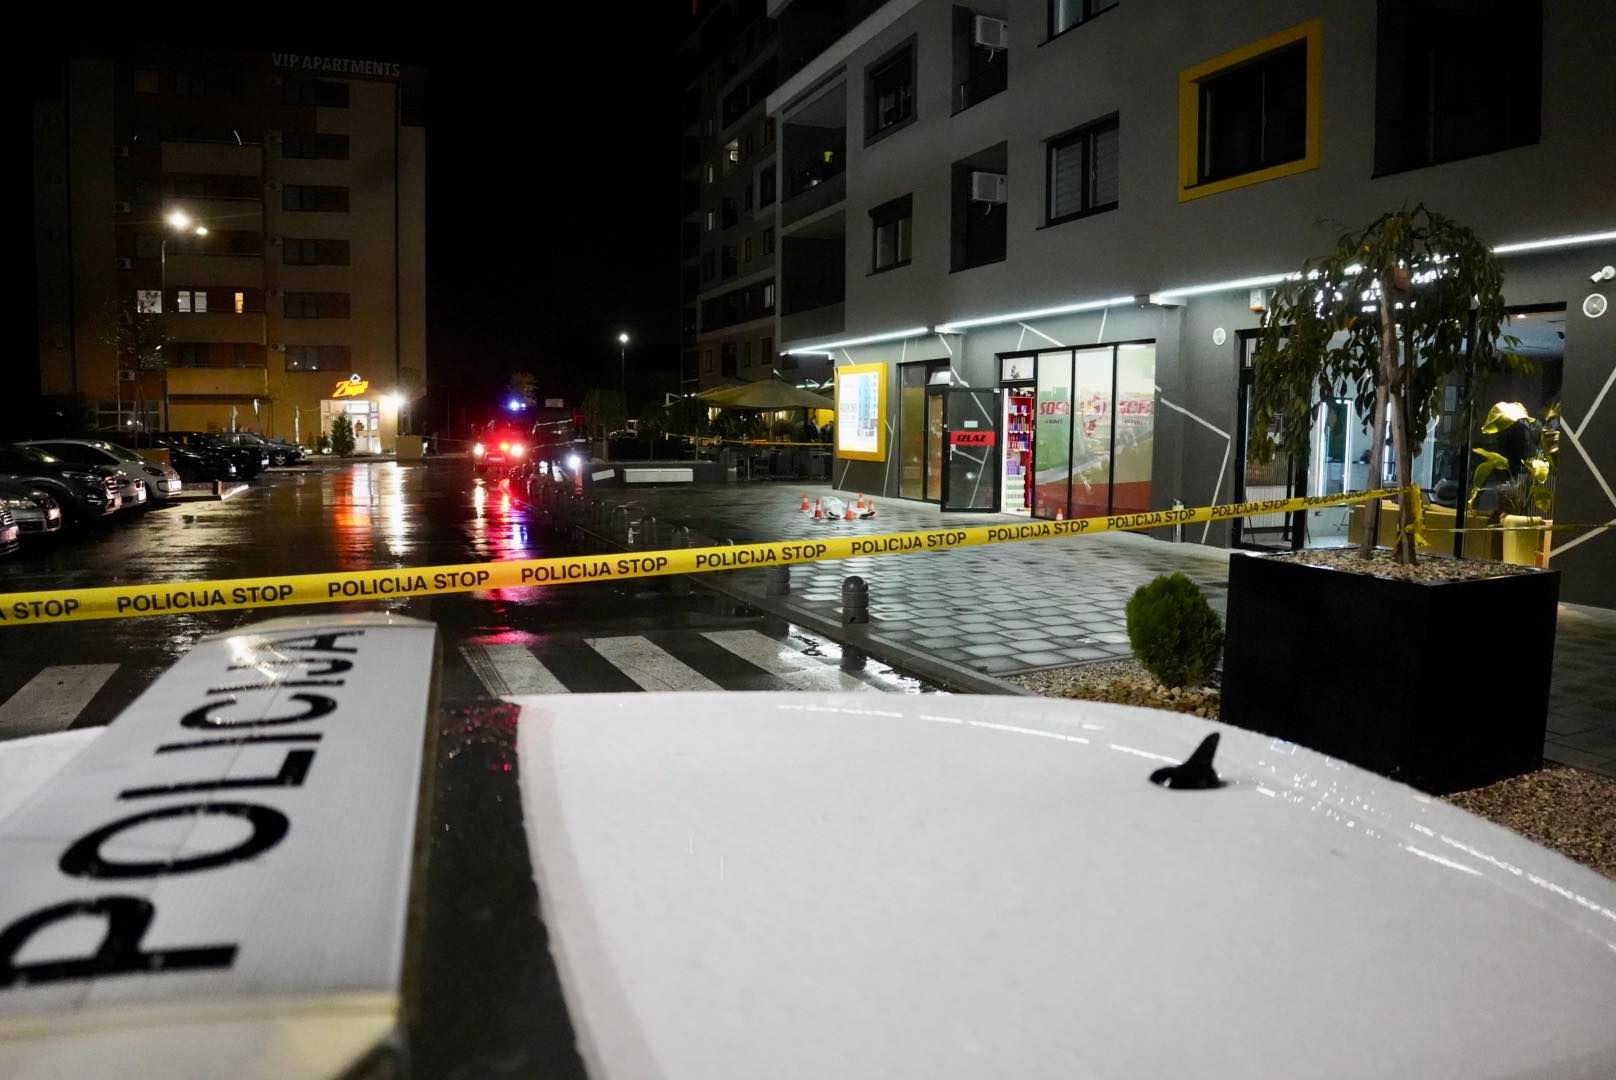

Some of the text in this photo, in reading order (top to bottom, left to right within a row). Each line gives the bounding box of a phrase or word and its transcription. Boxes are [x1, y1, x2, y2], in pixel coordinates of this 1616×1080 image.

[272, 52, 400, 77] VIP APARTMENTS
[957, 434, 987, 443] IZLAZ
[1107, 509, 1196, 530] POLICIJA STOP
[1211, 500, 1290, 518] POLICIJA STOP
[851, 531, 967, 555] POLICIJA STOP
[987, 520, 1089, 542] POLICIJA STOP
[695, 544, 827, 569] POLICIJA STOP
[521, 556, 668, 583] POLICIJA STOP
[328, 570, 490, 598] POLICIJA STOP
[14, 598, 80, 620] STOP
[117, 584, 293, 613] POLICIJA STOP
[0, 630, 365, 990] POLICIJA
